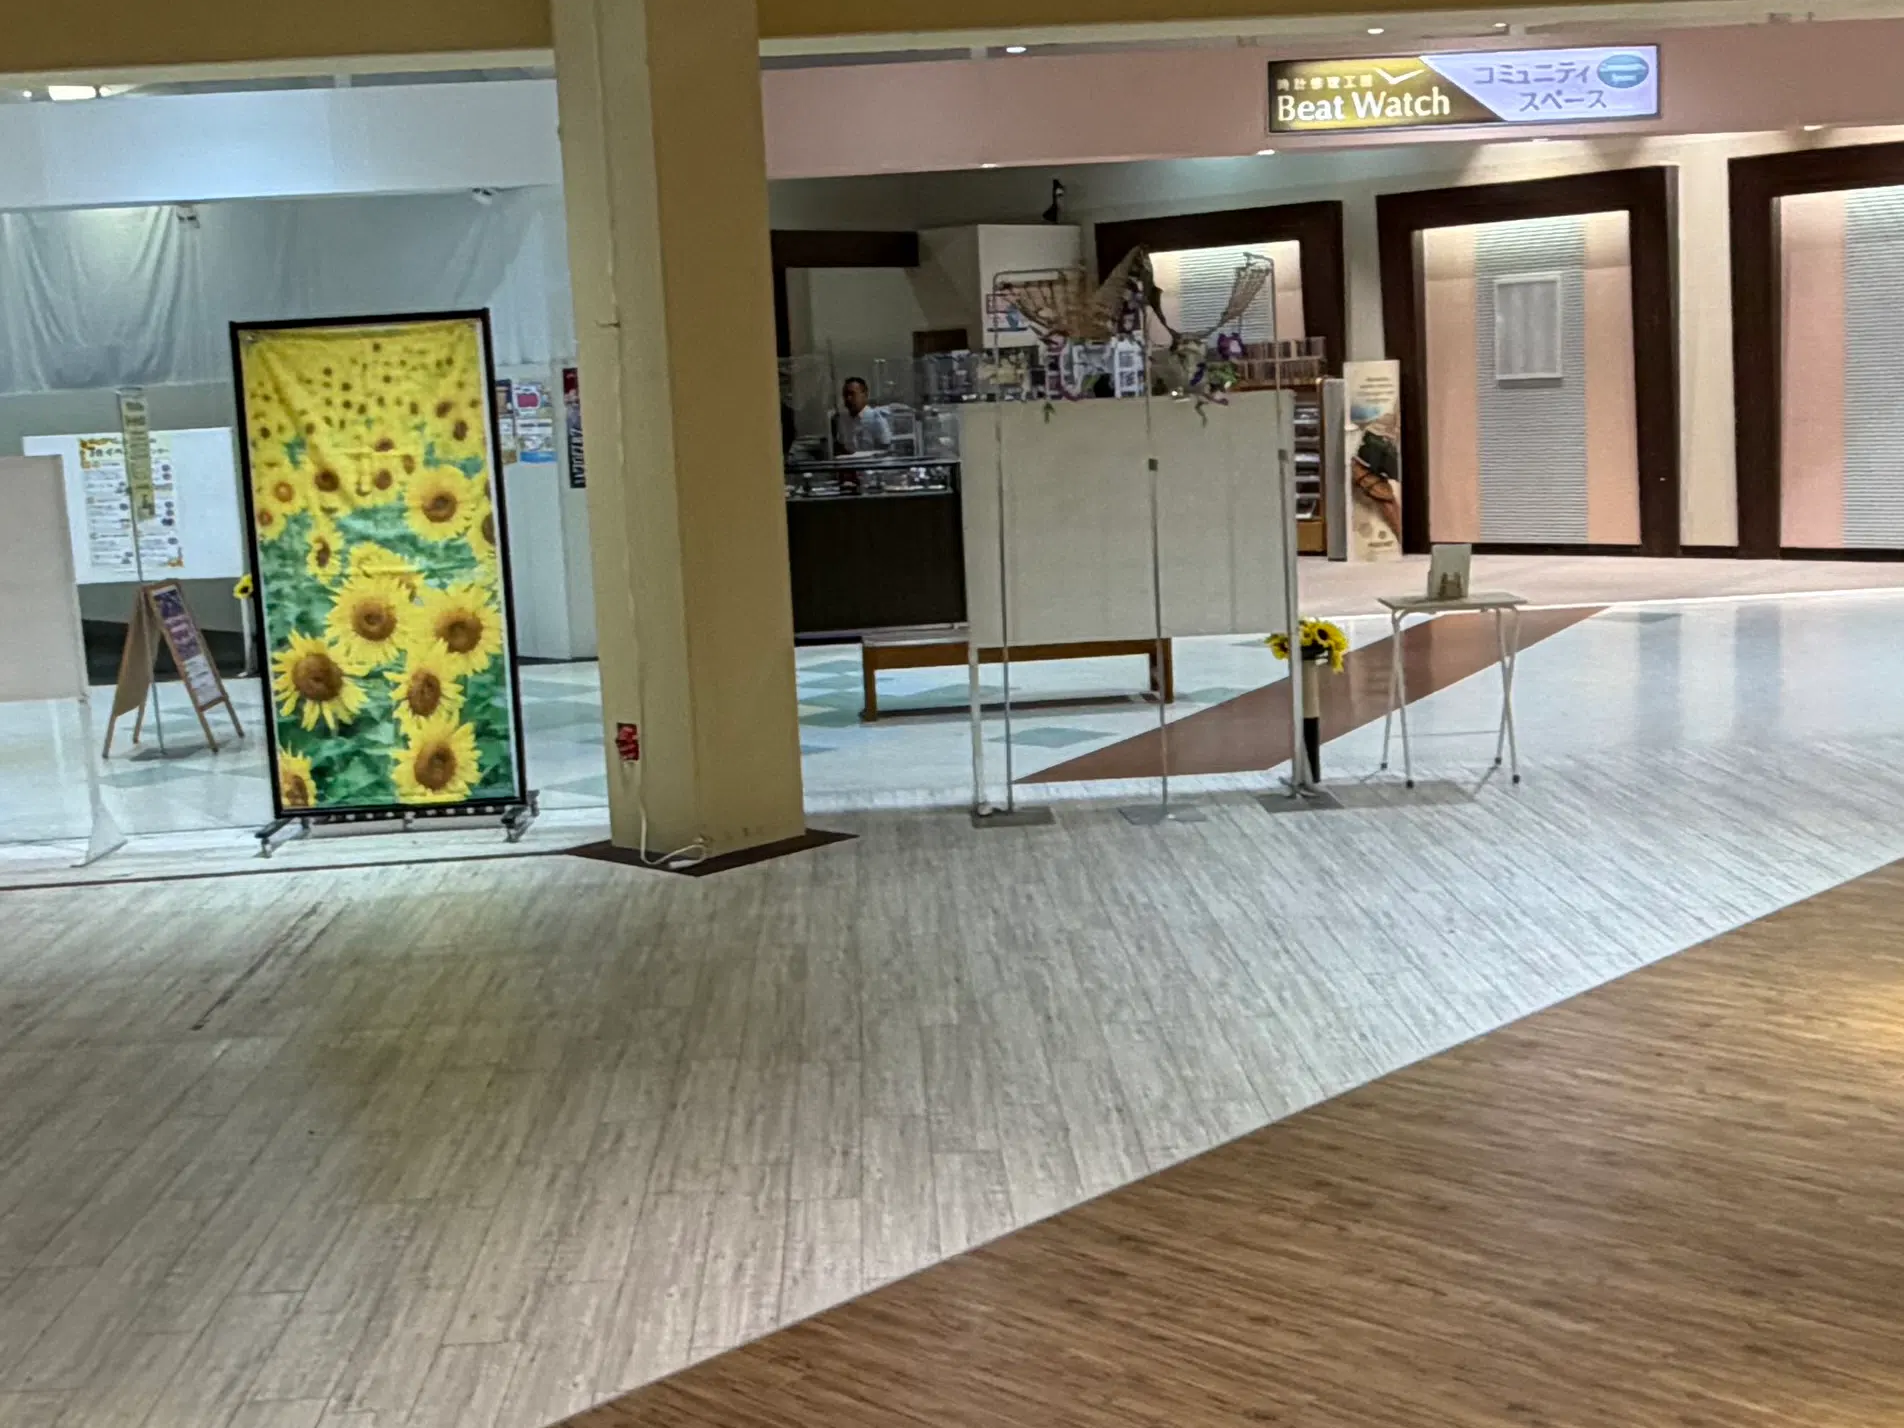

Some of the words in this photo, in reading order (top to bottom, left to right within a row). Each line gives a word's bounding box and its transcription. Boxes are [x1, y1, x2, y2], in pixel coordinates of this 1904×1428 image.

[1473, 61, 1591, 86] コミュニティ
[1277, 93, 1345, 123] Beat
[1350, 87, 1451, 118] Watch
[1518, 89, 1608, 113] スペース
